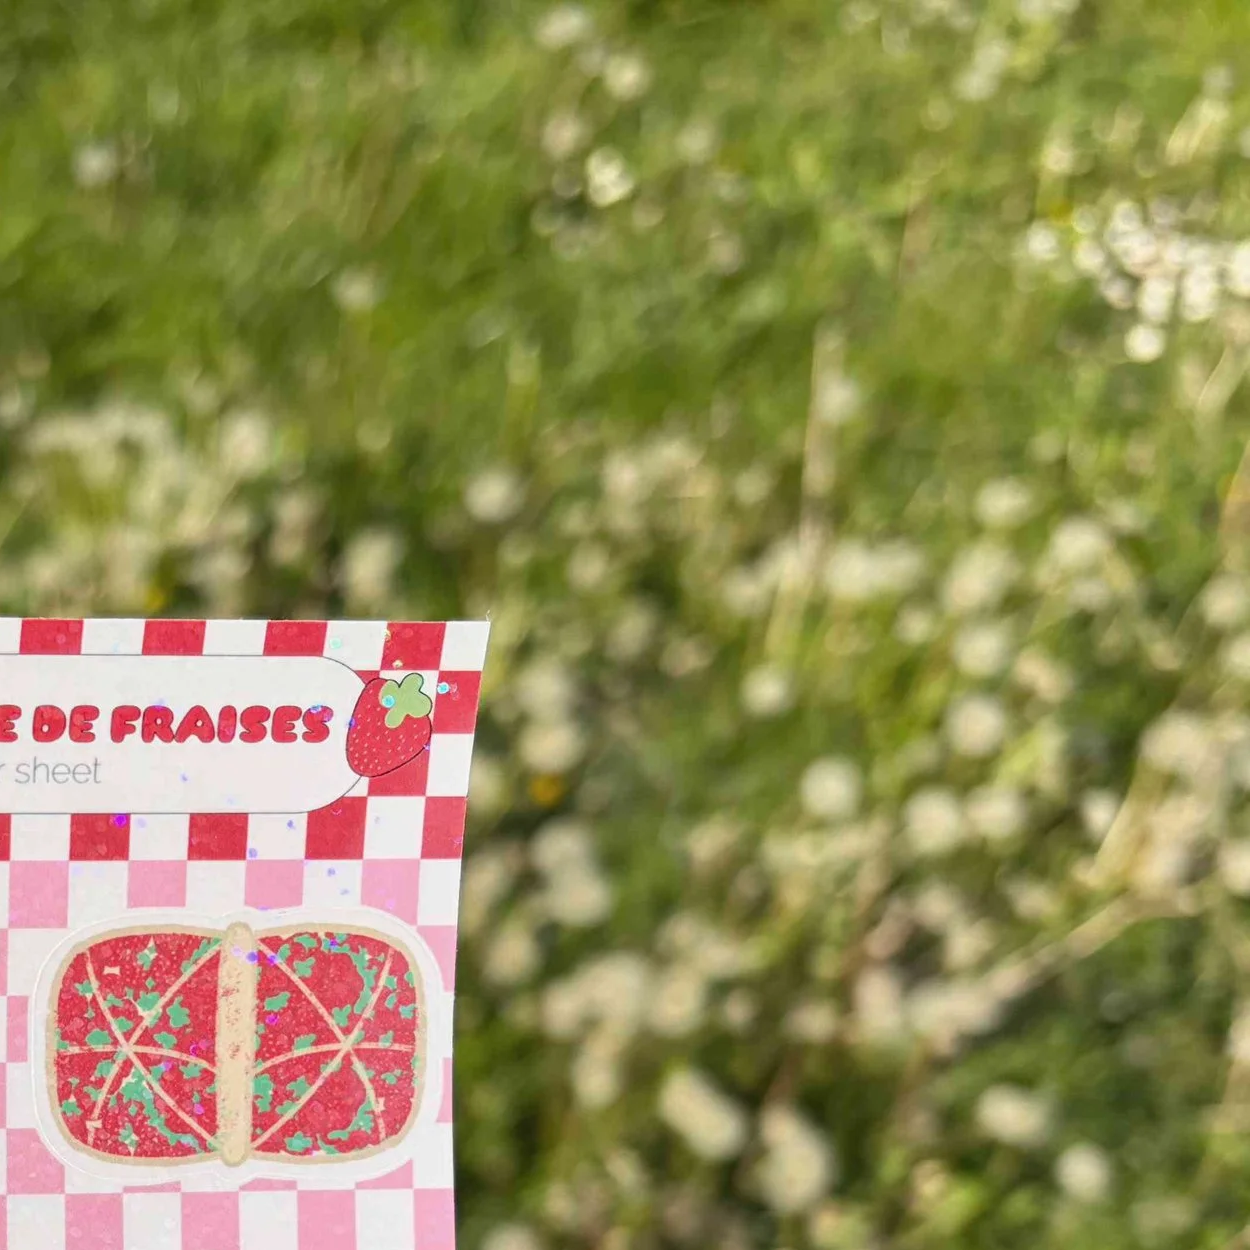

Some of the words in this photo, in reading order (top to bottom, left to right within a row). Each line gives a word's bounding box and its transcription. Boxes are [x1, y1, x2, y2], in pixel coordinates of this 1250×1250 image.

[32, 704, 100, 743] DE
[109, 704, 334, 744] FRAISES
[14, 756, 102, 785] sheet
